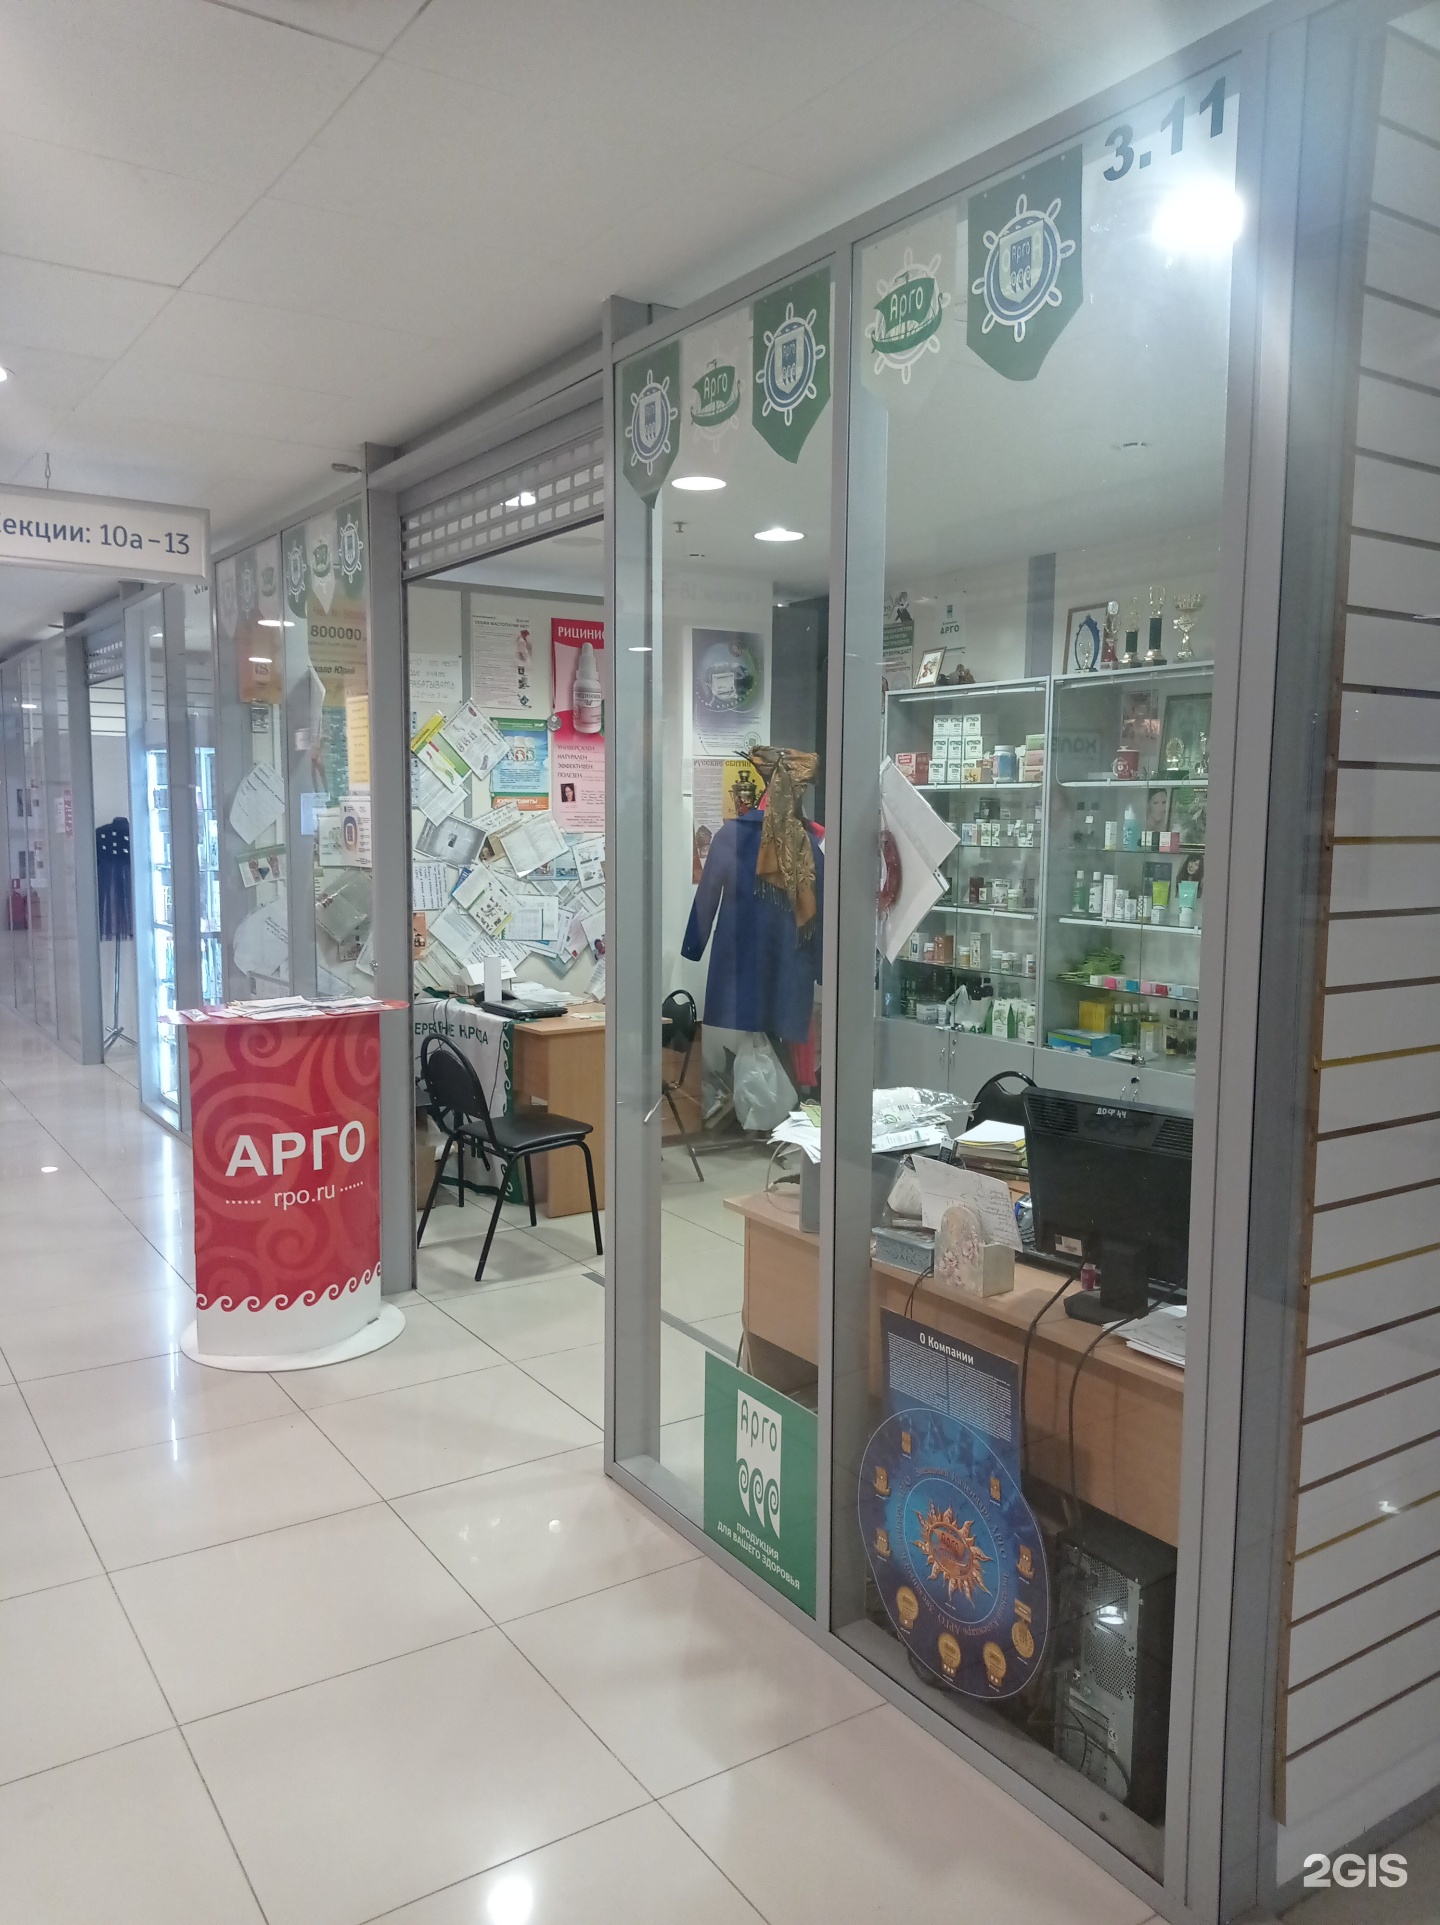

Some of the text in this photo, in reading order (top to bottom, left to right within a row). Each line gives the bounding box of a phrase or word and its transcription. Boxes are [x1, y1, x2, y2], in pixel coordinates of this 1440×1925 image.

[1103, 76, 1226, 181] 3.11
[890, 286, 924, 325] Арго
[703, 373, 728, 402] Арго
[0, 516, 91, 543] екции:
[311, 625, 361, 641] 800000
[940, 624, 960, 635] АРГО
[225, 1120, 366, 1177] АРГО
[919, 1332, 974, 1365] О Компании
[740, 1399, 778, 1452] Арго
[717, 1520, 800, 1590] ДЛЯ ВАШЕГО ЗДОРОВЬЯ
[736, 1522, 780, 1561] ПРОДУКЦИЯ
